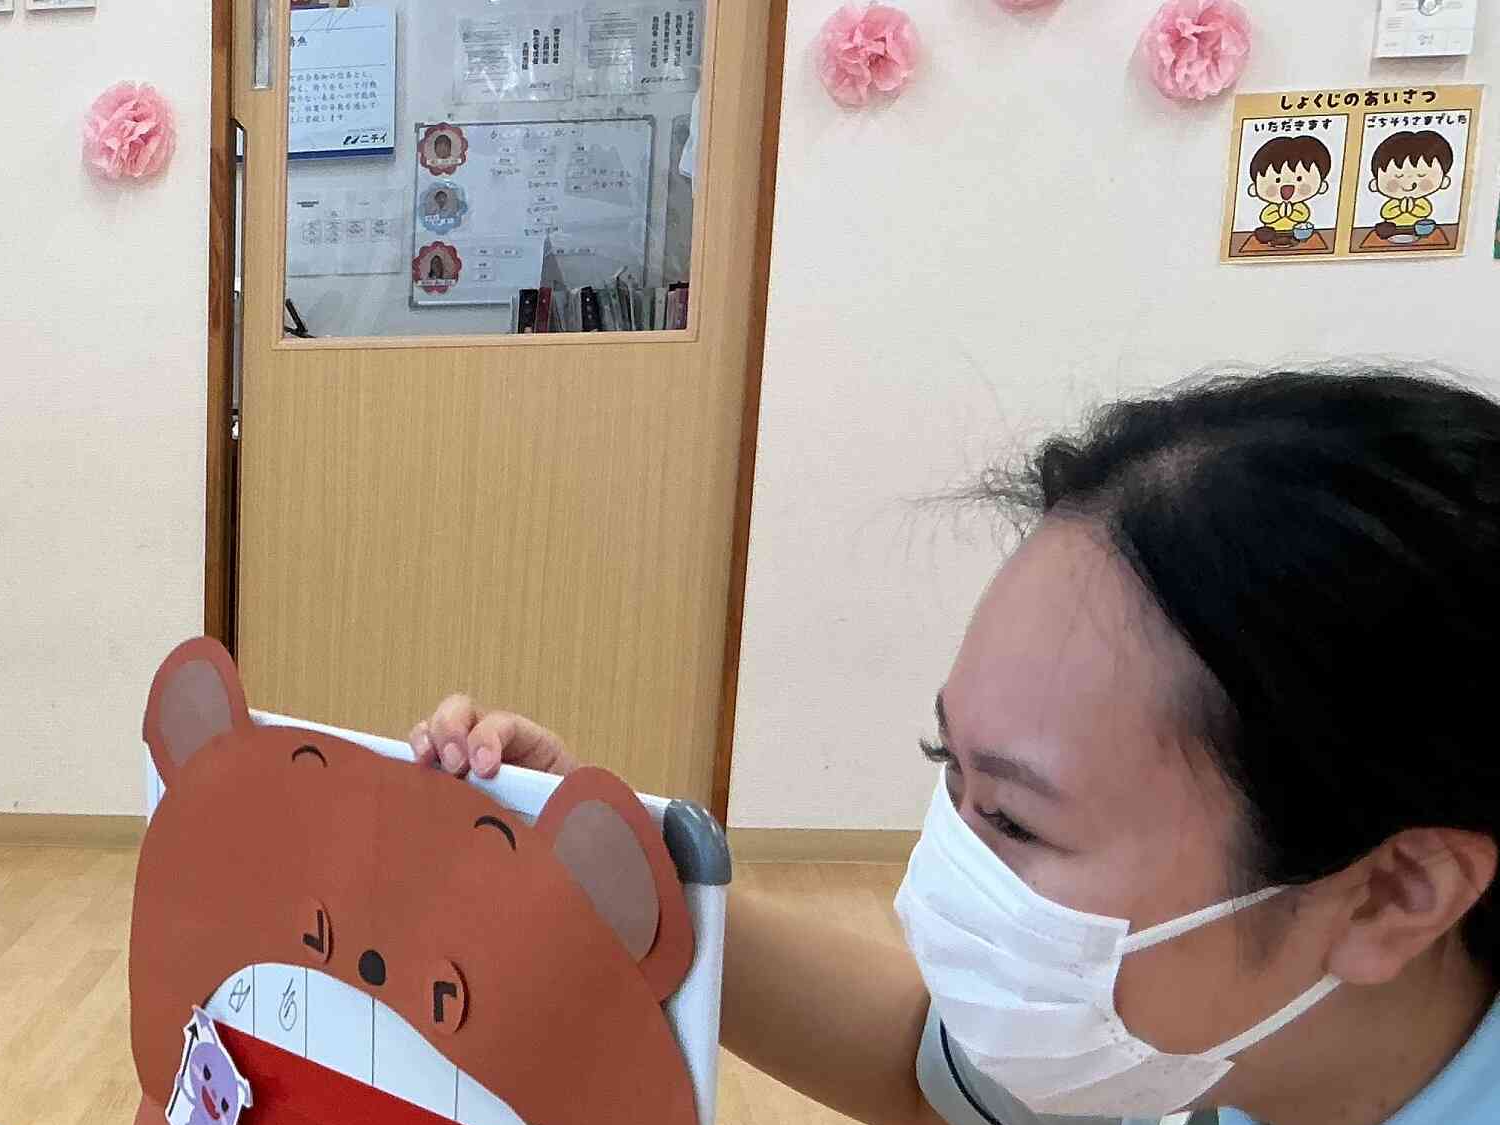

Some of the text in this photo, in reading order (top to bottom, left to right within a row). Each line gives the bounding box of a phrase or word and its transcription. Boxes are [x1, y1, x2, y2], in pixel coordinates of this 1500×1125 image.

[1280, 88, 1437, 111] しょくじのあいさつ
[1254, 118, 1333, 132] いただきます
[1367, 114, 1468, 128] ごちそうさまでした
